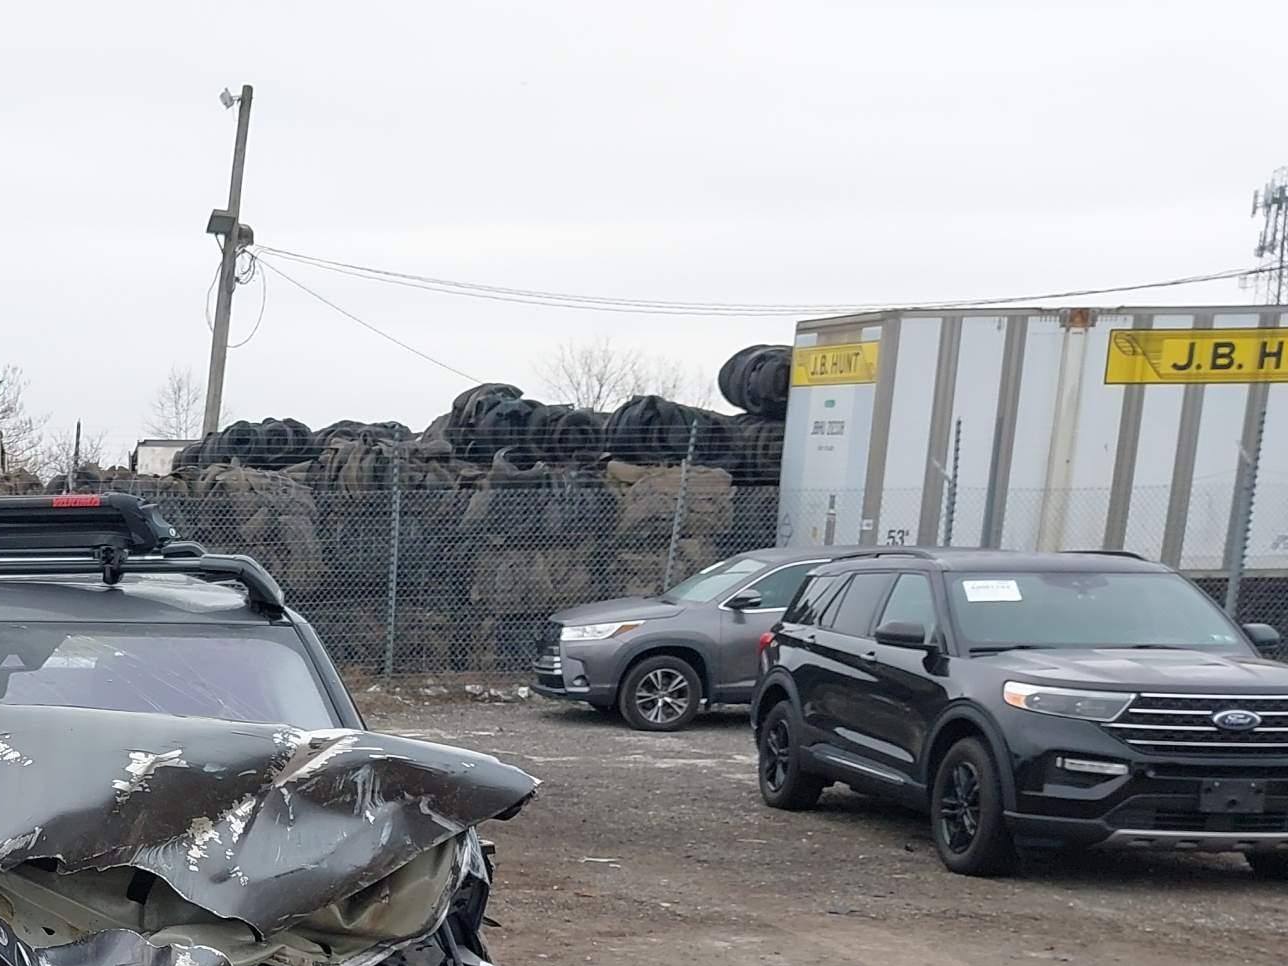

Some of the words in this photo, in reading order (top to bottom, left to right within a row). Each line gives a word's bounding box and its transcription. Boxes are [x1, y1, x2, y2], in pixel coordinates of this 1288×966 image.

[811, 355, 828, 376] J.B.
[831, 352, 860, 374] HUNT
[1171, 341, 1244, 371] J.B.
